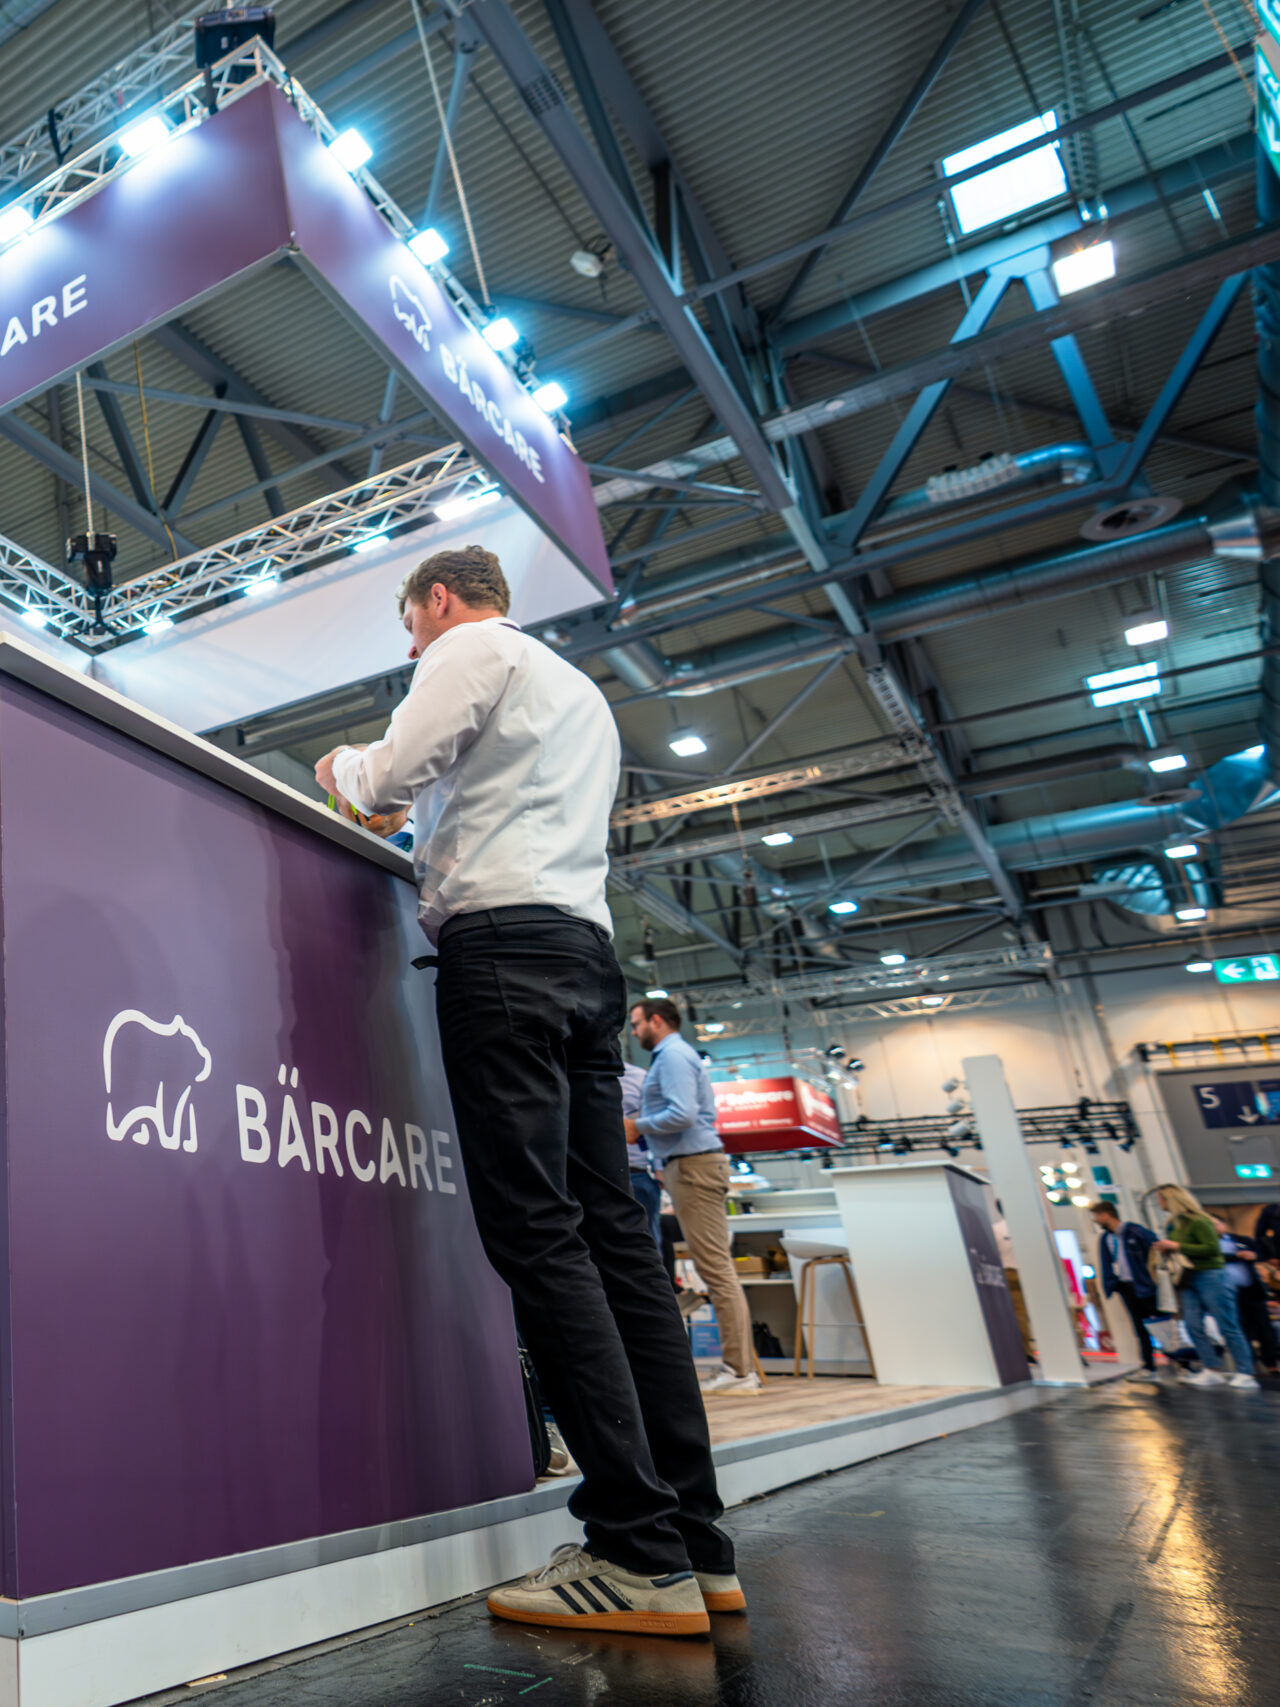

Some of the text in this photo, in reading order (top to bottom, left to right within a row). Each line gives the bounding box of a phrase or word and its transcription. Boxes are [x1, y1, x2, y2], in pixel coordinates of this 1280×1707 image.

[440, 344, 545, 483] BÄRCARE
[236, 1064, 457, 1195] BÄRCARE
[1200, 1087, 1220, 1109] 5
